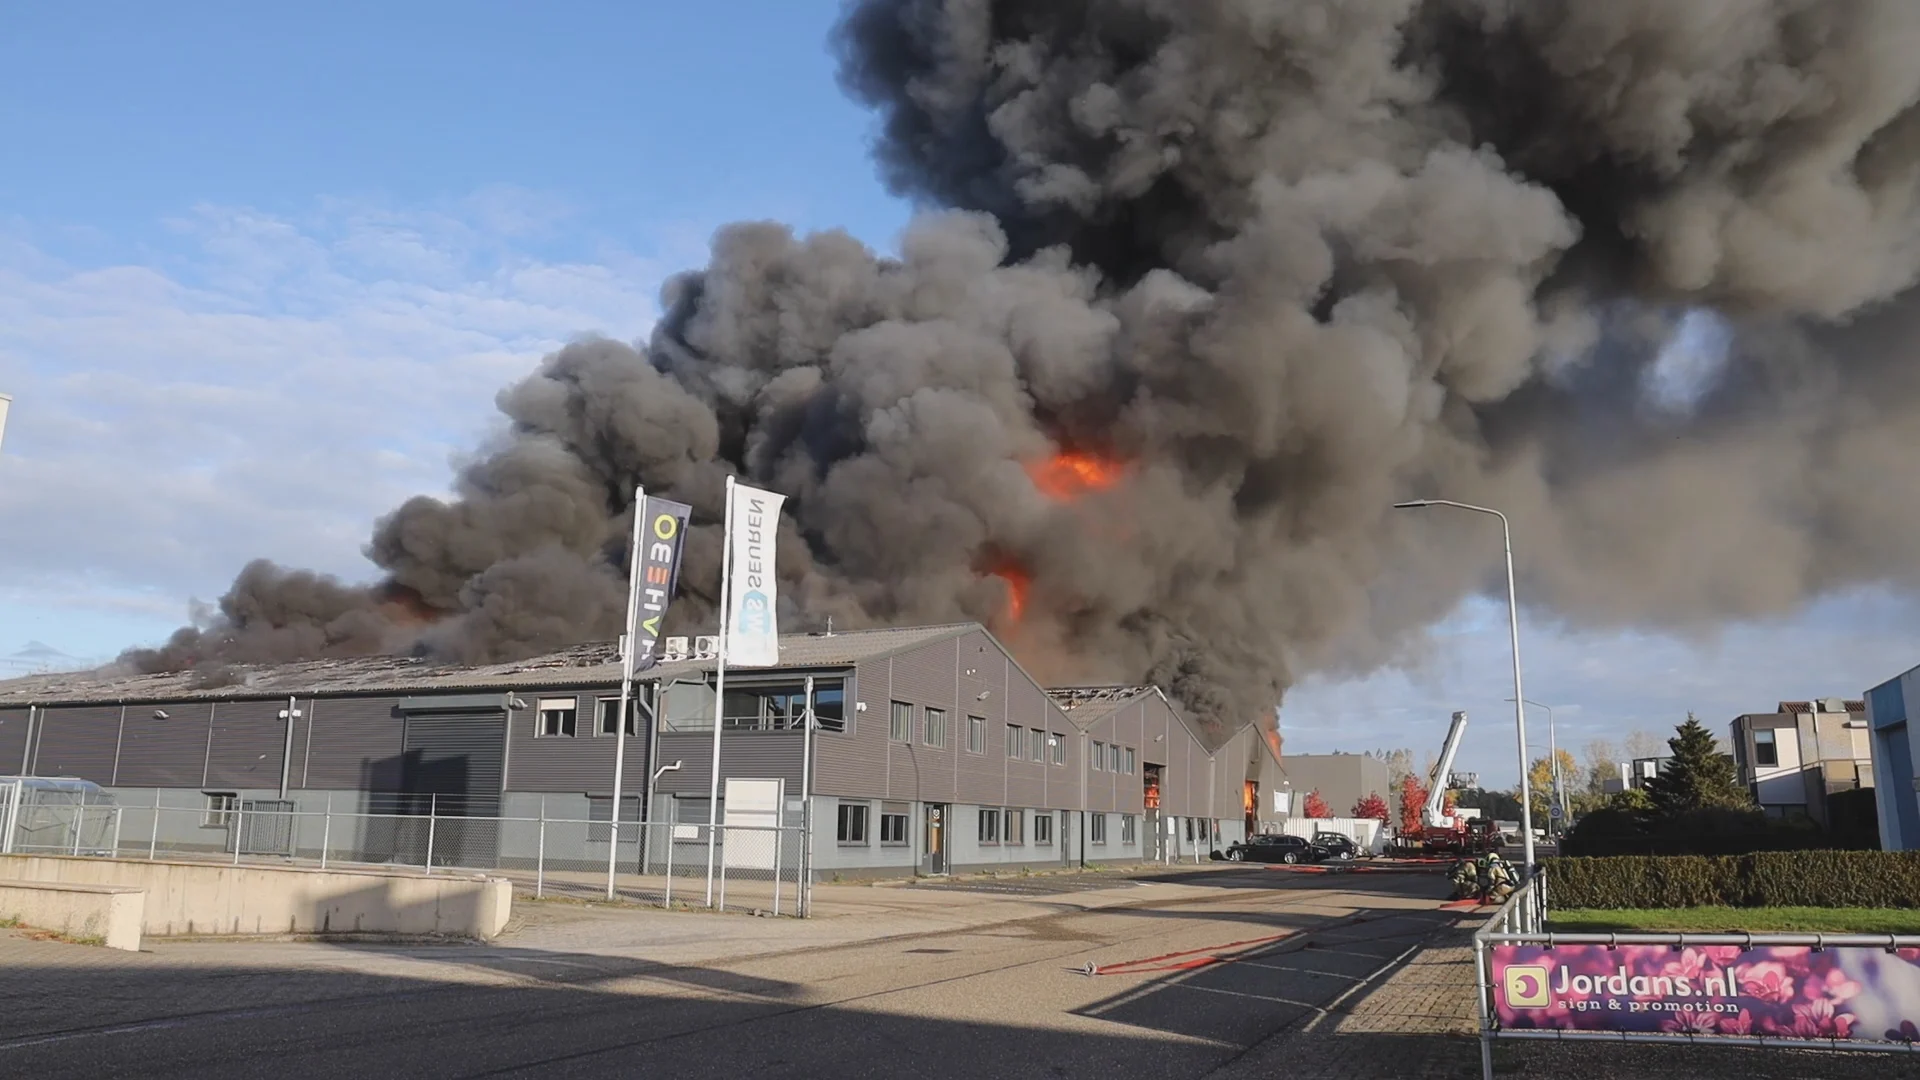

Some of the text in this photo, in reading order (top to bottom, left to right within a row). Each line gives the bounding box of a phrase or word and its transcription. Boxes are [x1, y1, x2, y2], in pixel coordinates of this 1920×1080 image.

[1555, 965, 1738, 997] Jordans.nl
[1557, 998, 1739, 1013] sign & promotion
